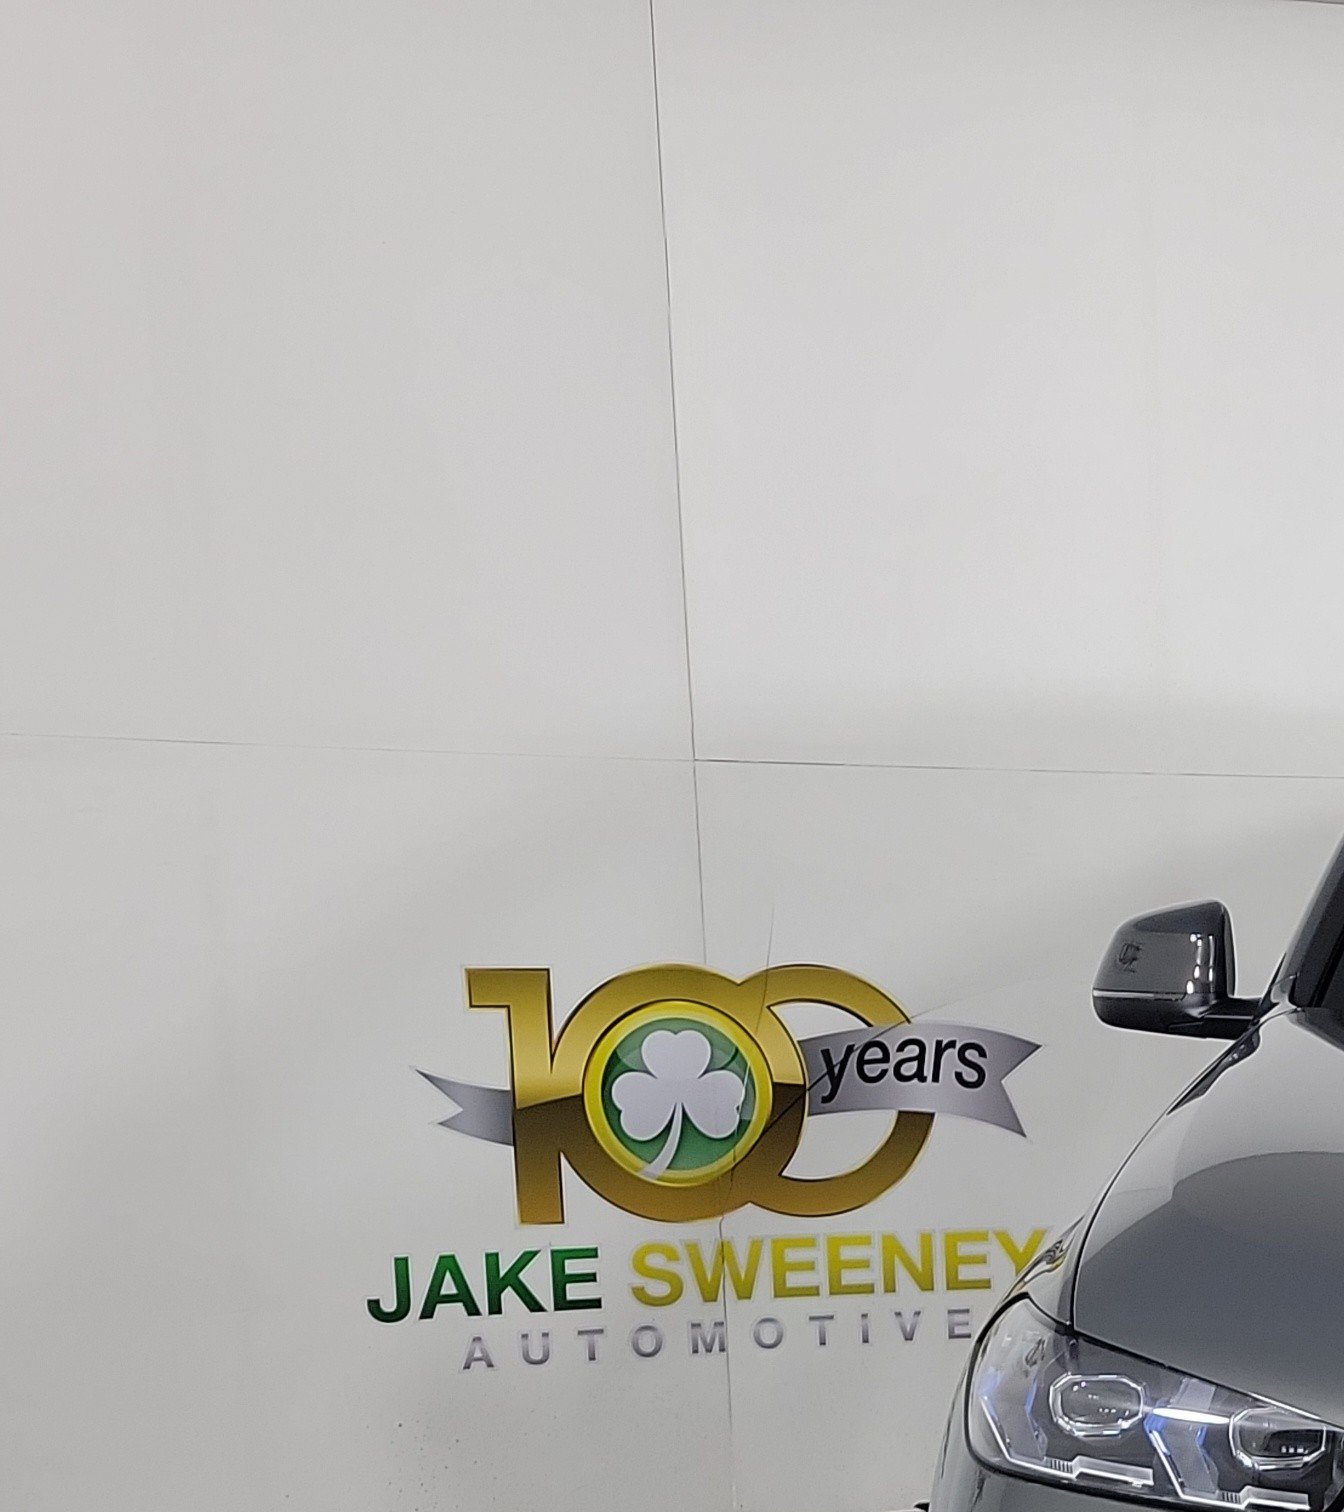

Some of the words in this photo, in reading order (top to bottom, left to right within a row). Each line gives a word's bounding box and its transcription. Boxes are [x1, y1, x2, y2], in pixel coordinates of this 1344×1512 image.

[465, 963, 936, 1225] 100
[818, 1037, 988, 1103] years
[366, 1247, 602, 1324] JAKE
[630, 1228, 1048, 1308] SWEENEY
[463, 1308, 971, 1371] AUTOMOTIVE
